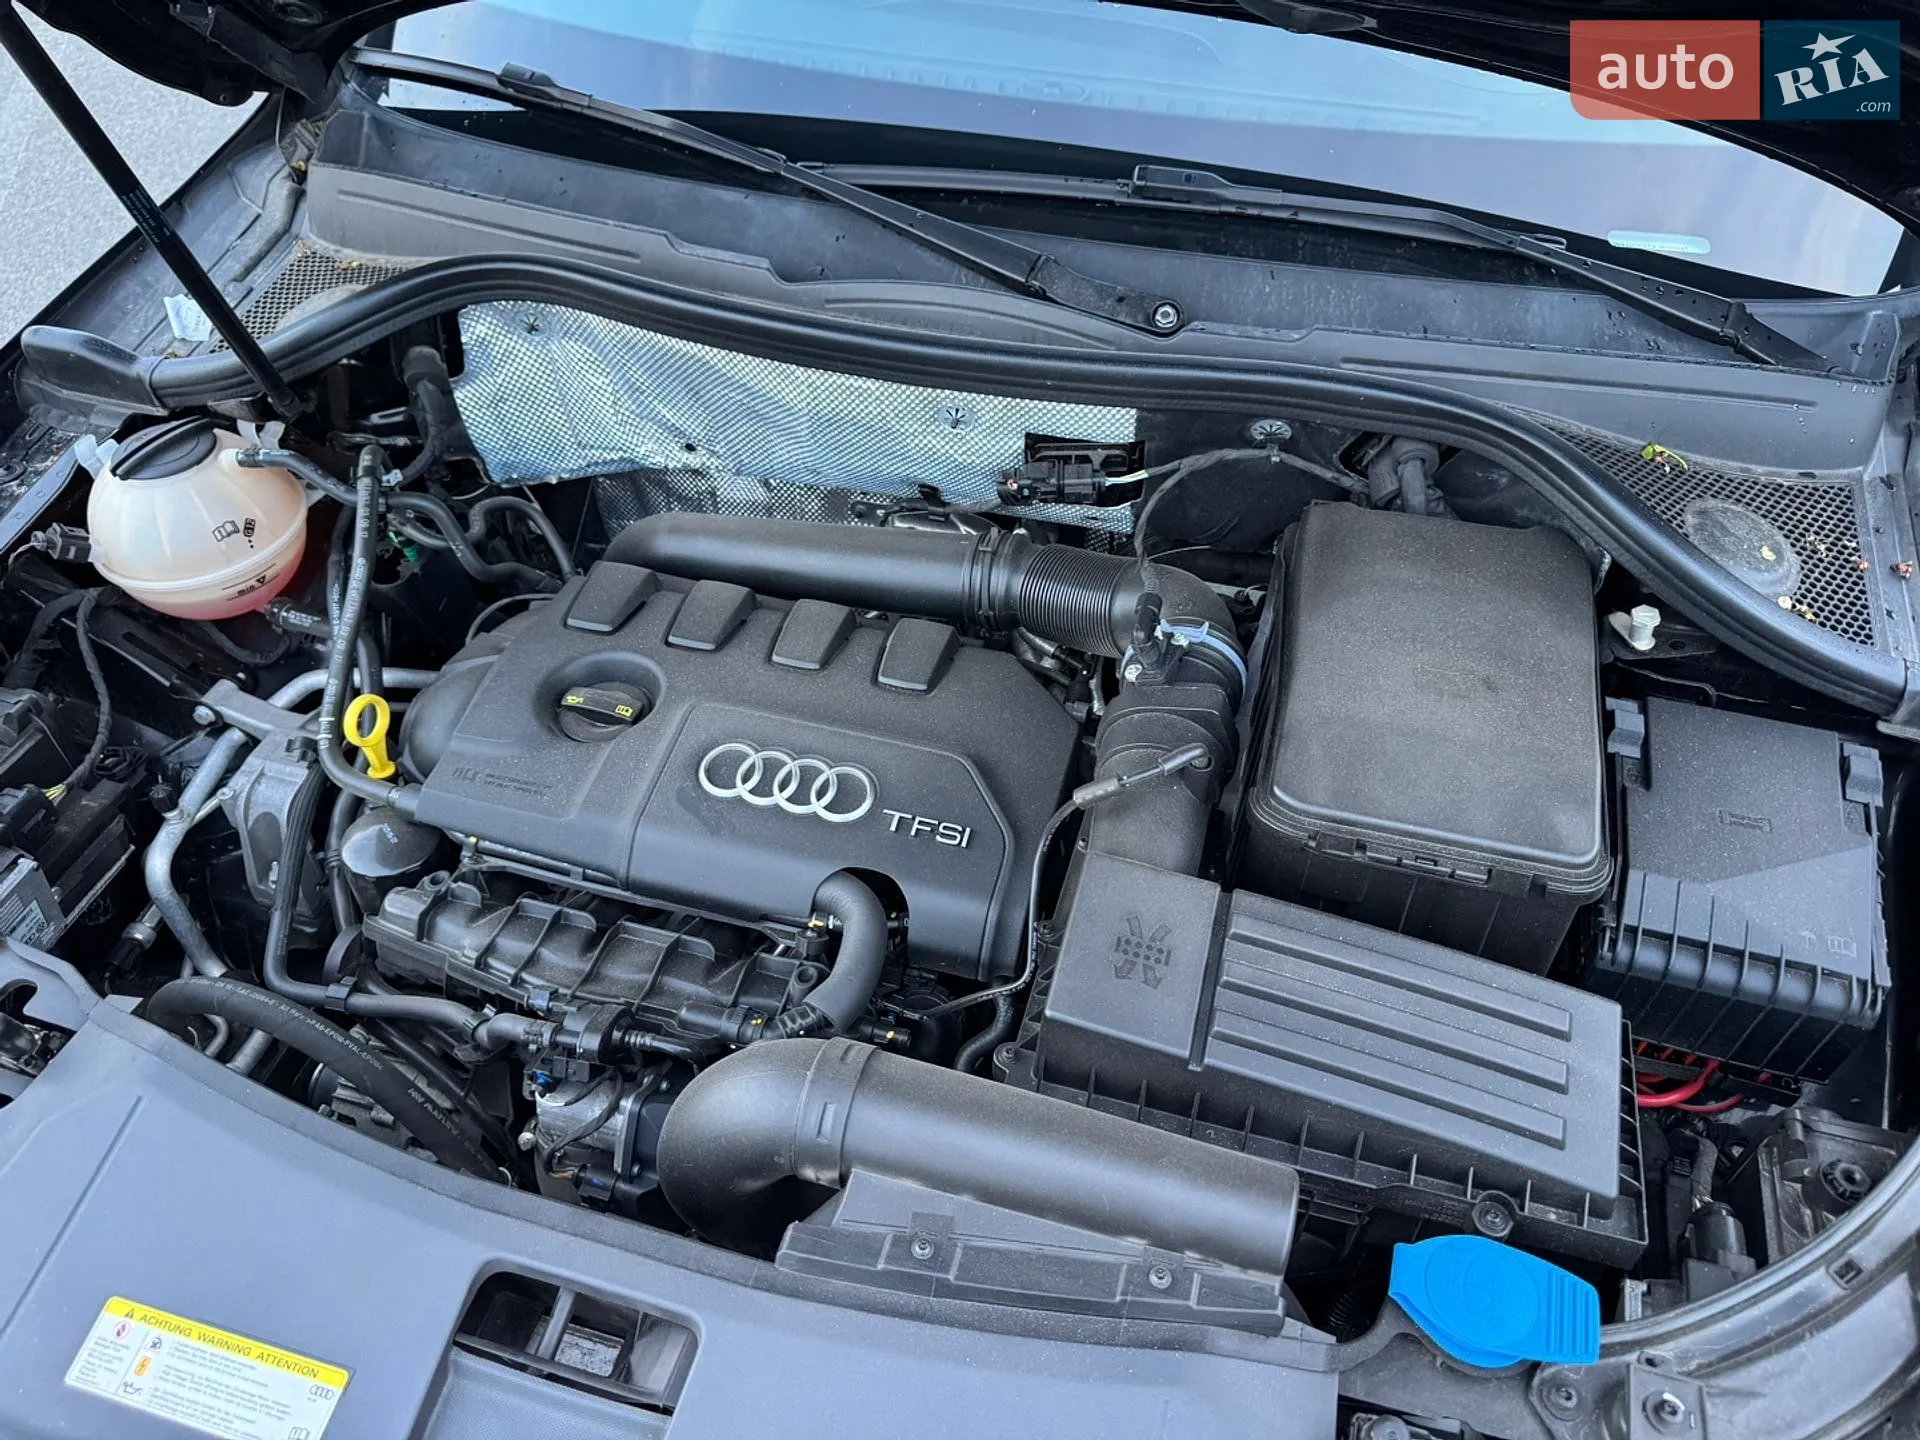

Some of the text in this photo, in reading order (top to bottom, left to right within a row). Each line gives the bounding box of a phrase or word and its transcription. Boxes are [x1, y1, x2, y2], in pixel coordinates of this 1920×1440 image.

[882, 809, 971, 848] TFSI
[139, 1312, 193, 1338] ACHTUNG
[197, 1331, 252, 1358] WARNING
[255, 1350, 320, 1379] ATTENTION
